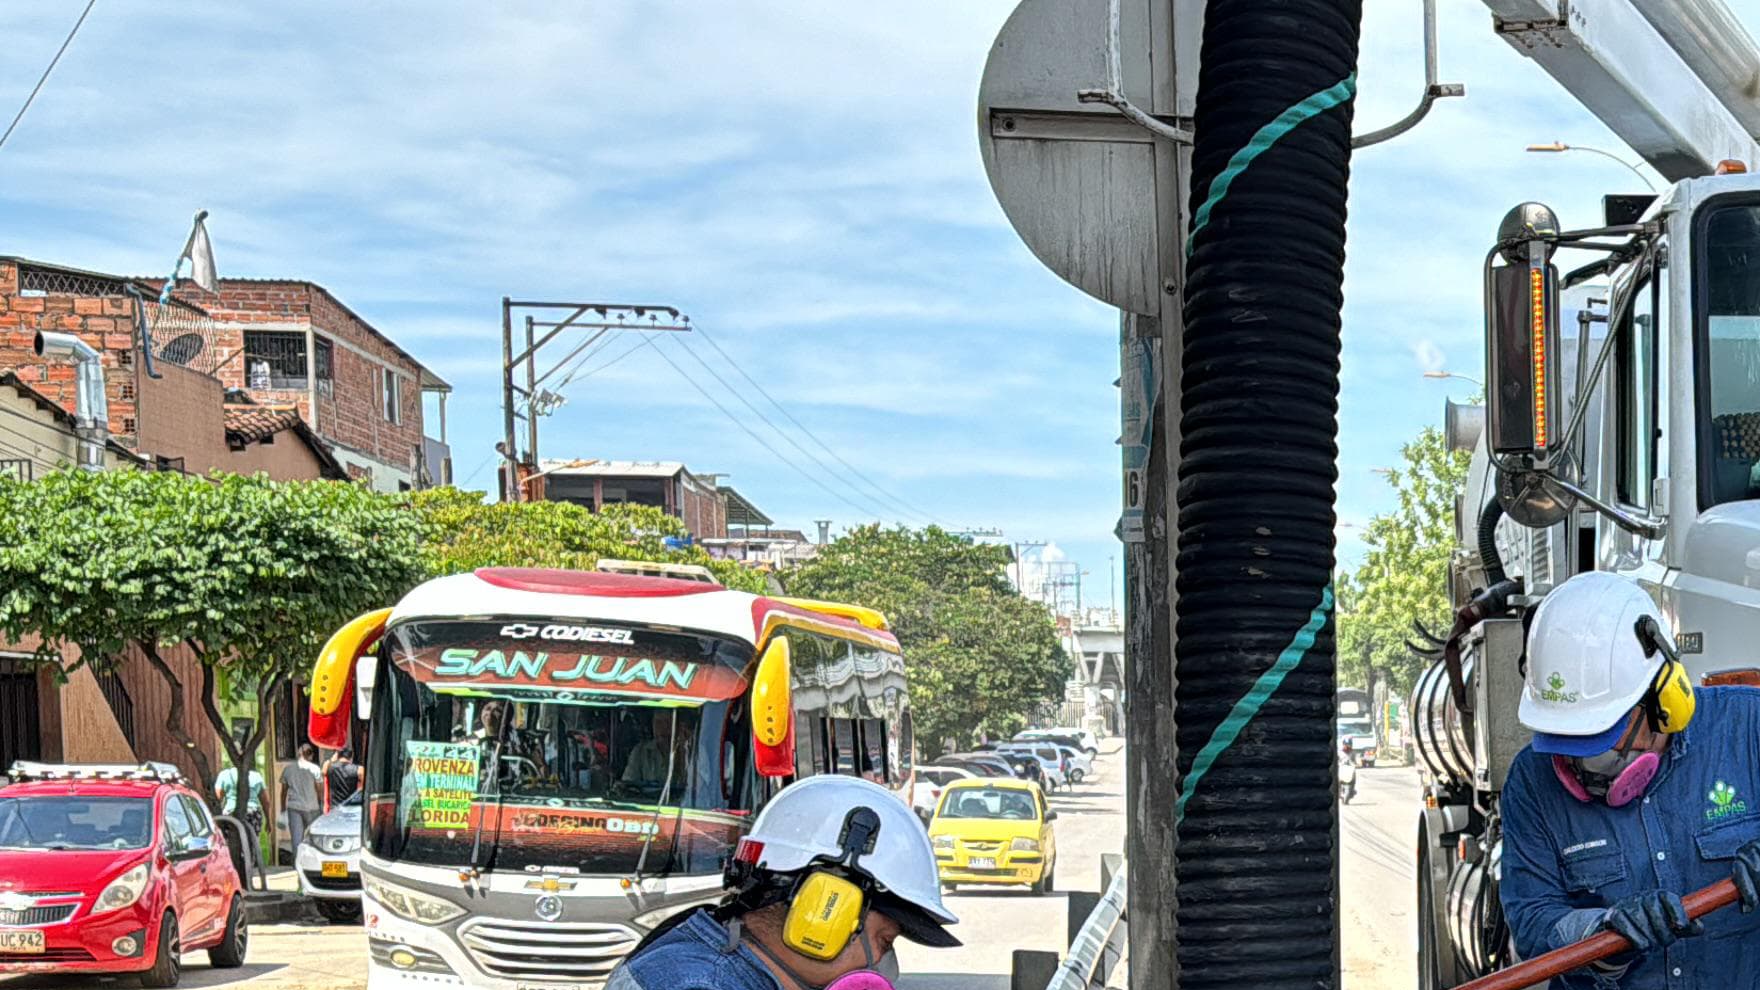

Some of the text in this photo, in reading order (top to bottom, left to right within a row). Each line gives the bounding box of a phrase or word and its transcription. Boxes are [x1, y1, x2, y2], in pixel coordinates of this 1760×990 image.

[540, 625, 635, 645] CODIESEL
[434, 649, 699, 690] SAN JUAN
[1541, 689, 1577, 703] EMPAS
[1706, 800, 1746, 820] EMPAS
